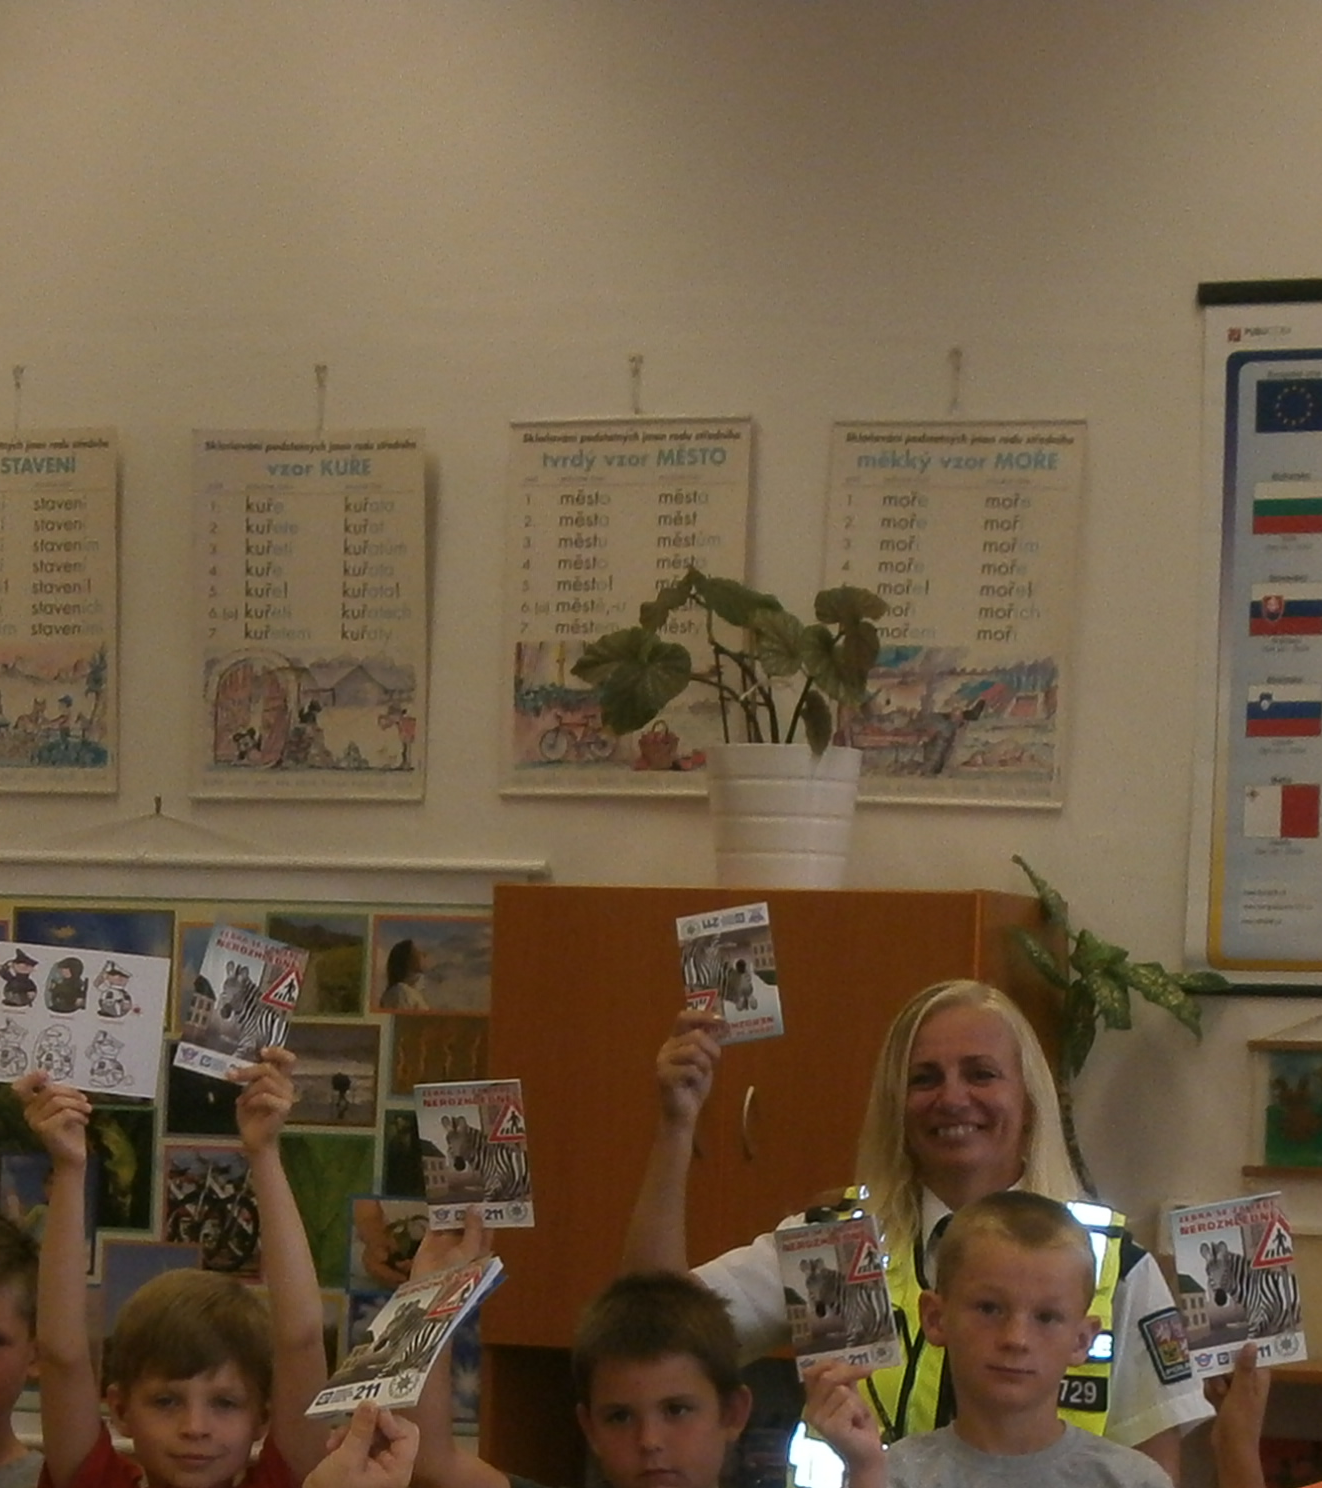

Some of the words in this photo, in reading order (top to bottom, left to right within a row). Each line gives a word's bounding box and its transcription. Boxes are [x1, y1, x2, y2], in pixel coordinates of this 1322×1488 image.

[605, 453, 649, 467] vzor
[941, 457, 987, 469] vzor
[267, 463, 313, 476] vzor
[485, 1208, 504, 1220] 211
[353, 1382, 381, 1401] 211
